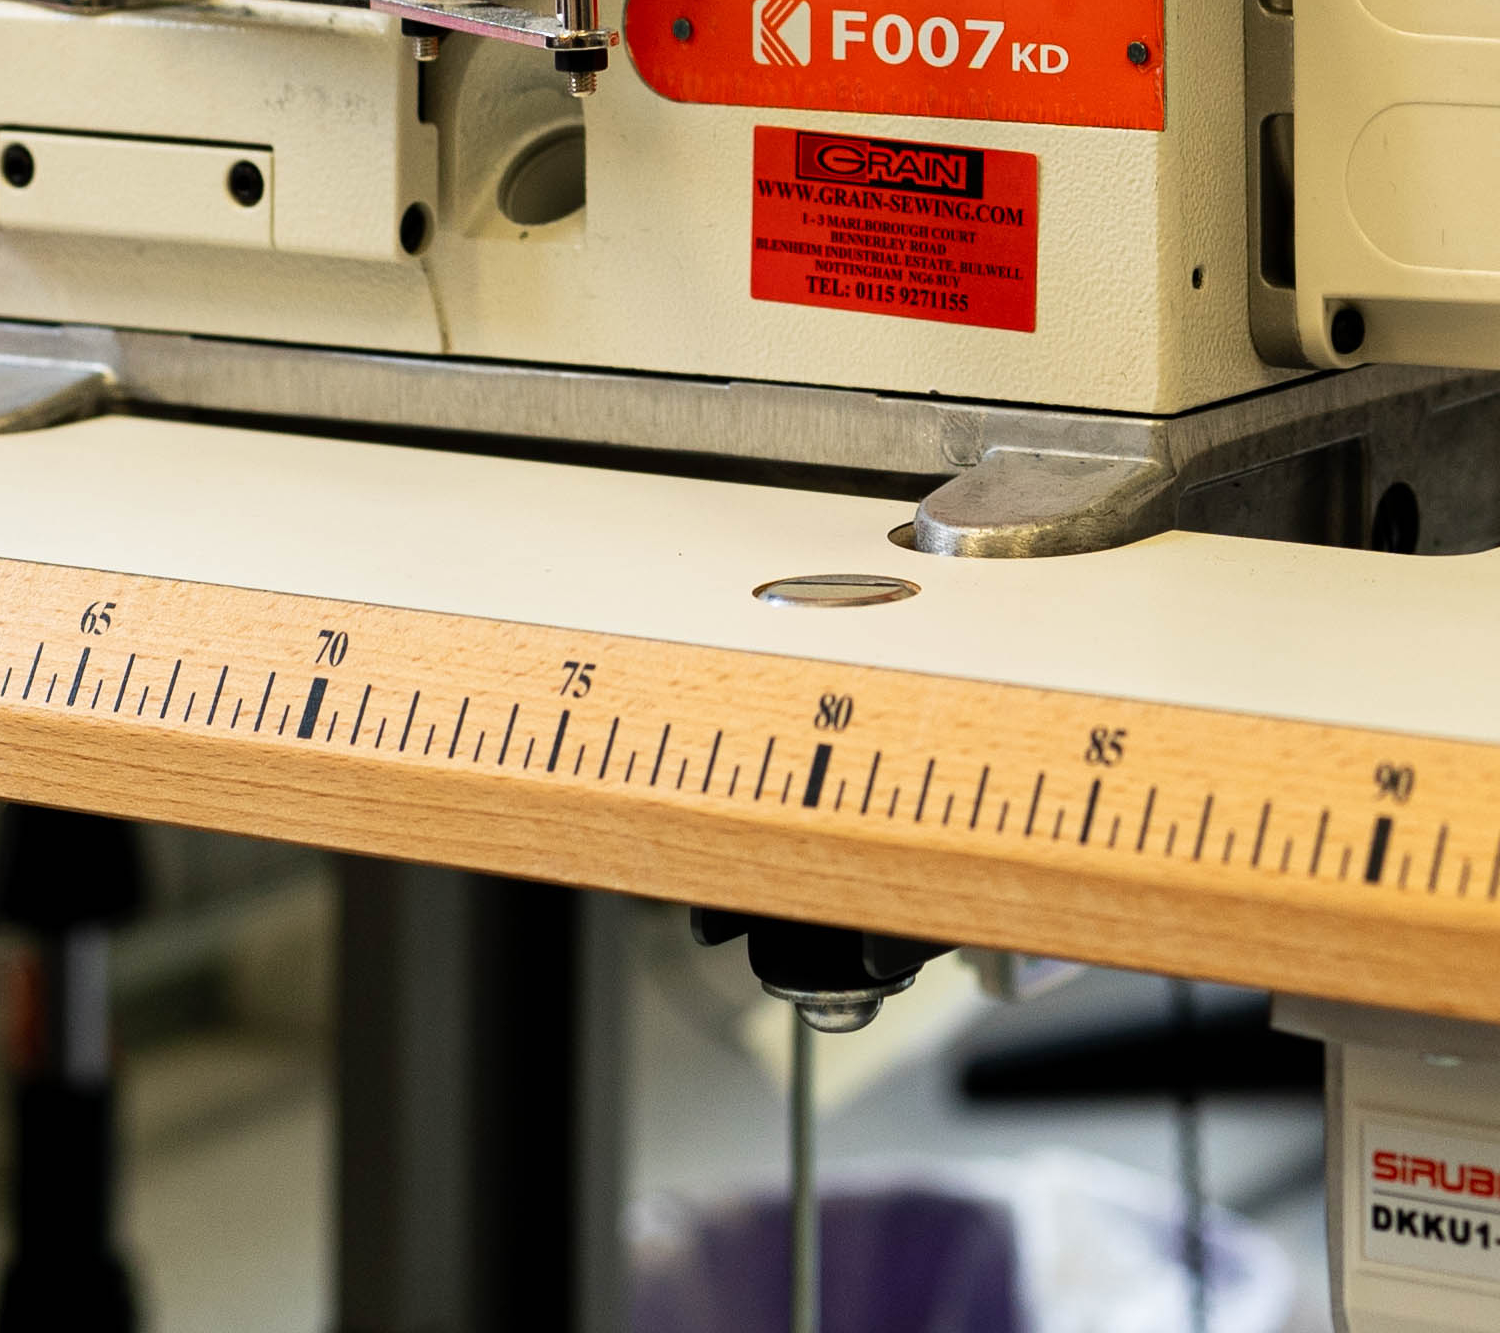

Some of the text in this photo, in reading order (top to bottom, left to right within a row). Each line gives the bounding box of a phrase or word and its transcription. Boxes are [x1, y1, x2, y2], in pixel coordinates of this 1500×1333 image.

[815, 142, 967, 190] GRAIN
[757, 179, 1024, 226] WWW.GRAIN-SEWING.COM
[827, 214, 928, 239] MARLBOROUGH
[931, 227, 977, 245] COURT
[830, 230, 947, 256] BENNERLEY ROAD
[755, 237, 823, 257] BLENHEIM
[825, 244, 901, 265] INDUSTRIAL
[814, 259, 903, 282] NOTTINGHAM
[908, 270, 934, 284] NG6
[805, 275, 970, 312] TEL: 0115 9271155
[79, 600, 117, 636] 65
[314, 629, 349, 667] 70
[558, 660, 597, 698] 75
[812, 693, 854, 731] 80
[1083, 724, 1127, 767] 85
[1372, 762, 1416, 804] 90
